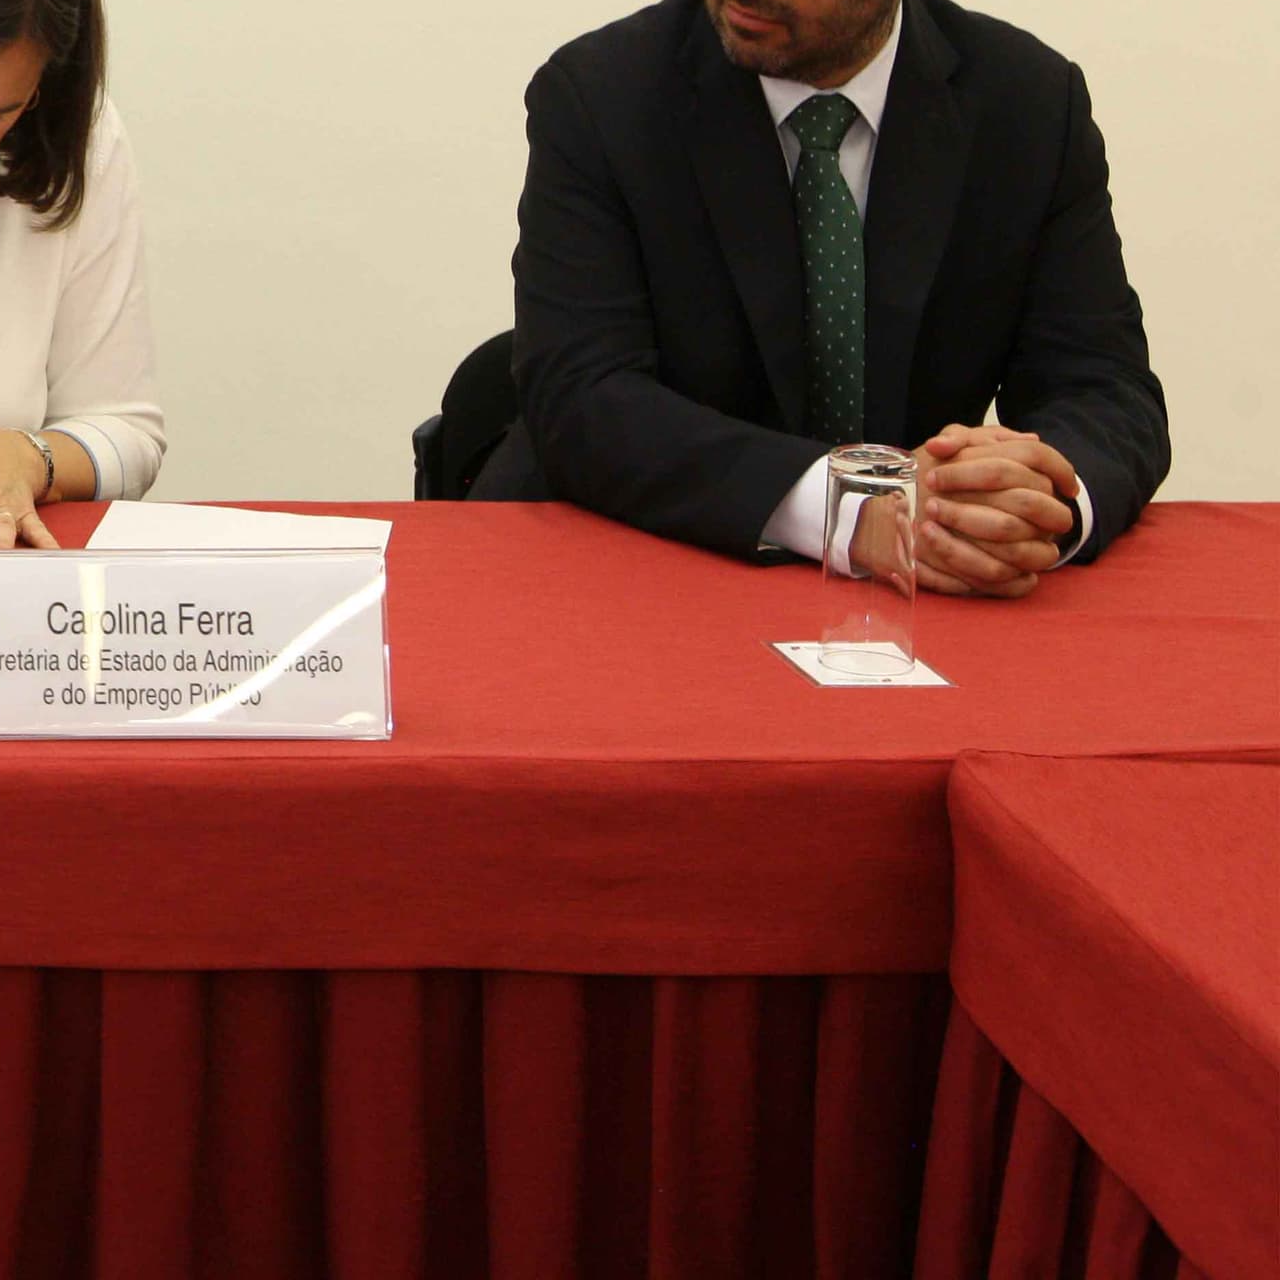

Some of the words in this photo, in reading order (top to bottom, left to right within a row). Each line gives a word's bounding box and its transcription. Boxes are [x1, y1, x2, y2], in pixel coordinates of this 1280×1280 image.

[47, 601, 168, 635] Caolina
[178, 602, 254, 635] Ferra
[67, 648, 90, 671] de
[99, 648, 167, 671] Estado
[173, 649, 197, 672] da
[42, 687, 55, 705] e
[61, 682, 86, 705] do
[94, 682, 183, 711] Emprego
